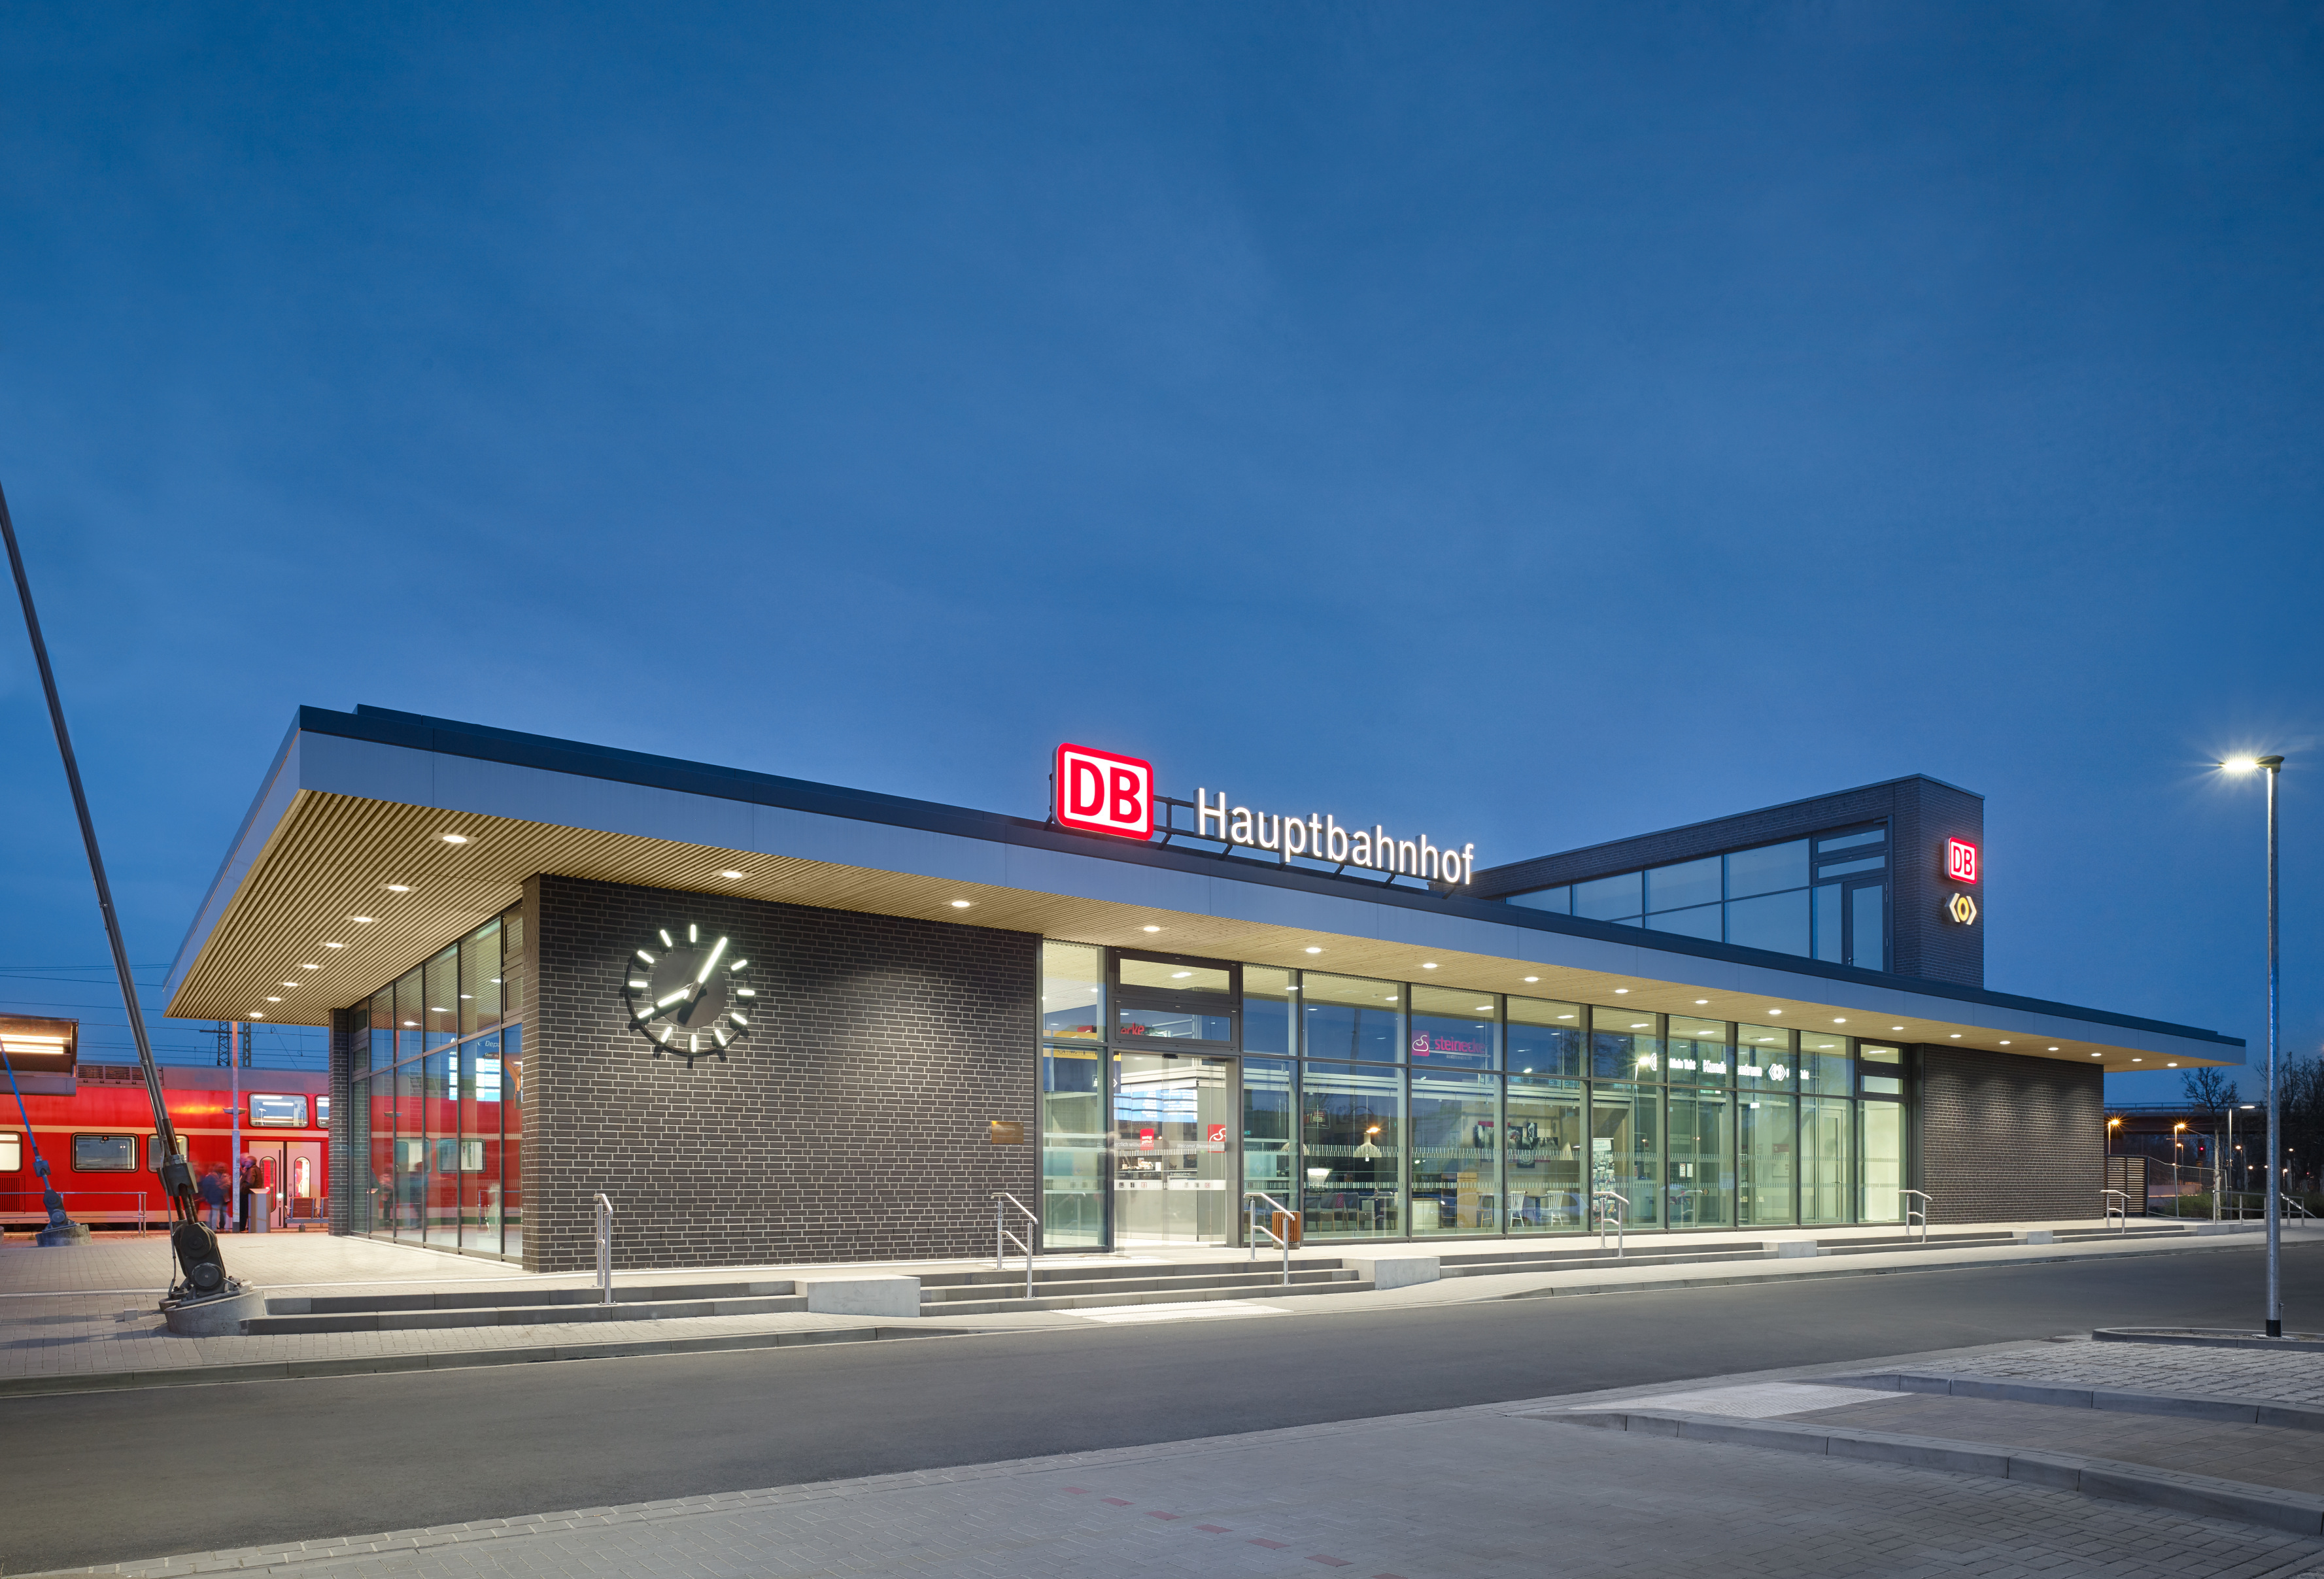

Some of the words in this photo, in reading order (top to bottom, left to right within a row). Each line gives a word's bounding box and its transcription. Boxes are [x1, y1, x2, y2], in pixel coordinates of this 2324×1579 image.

[1070, 758, 1142, 824] DB
[1195, 787, 1475, 885] Hauptbahnhof
[1953, 845, 1973, 876] DB
[1434, 1036, 1486, 1054] steinecke
